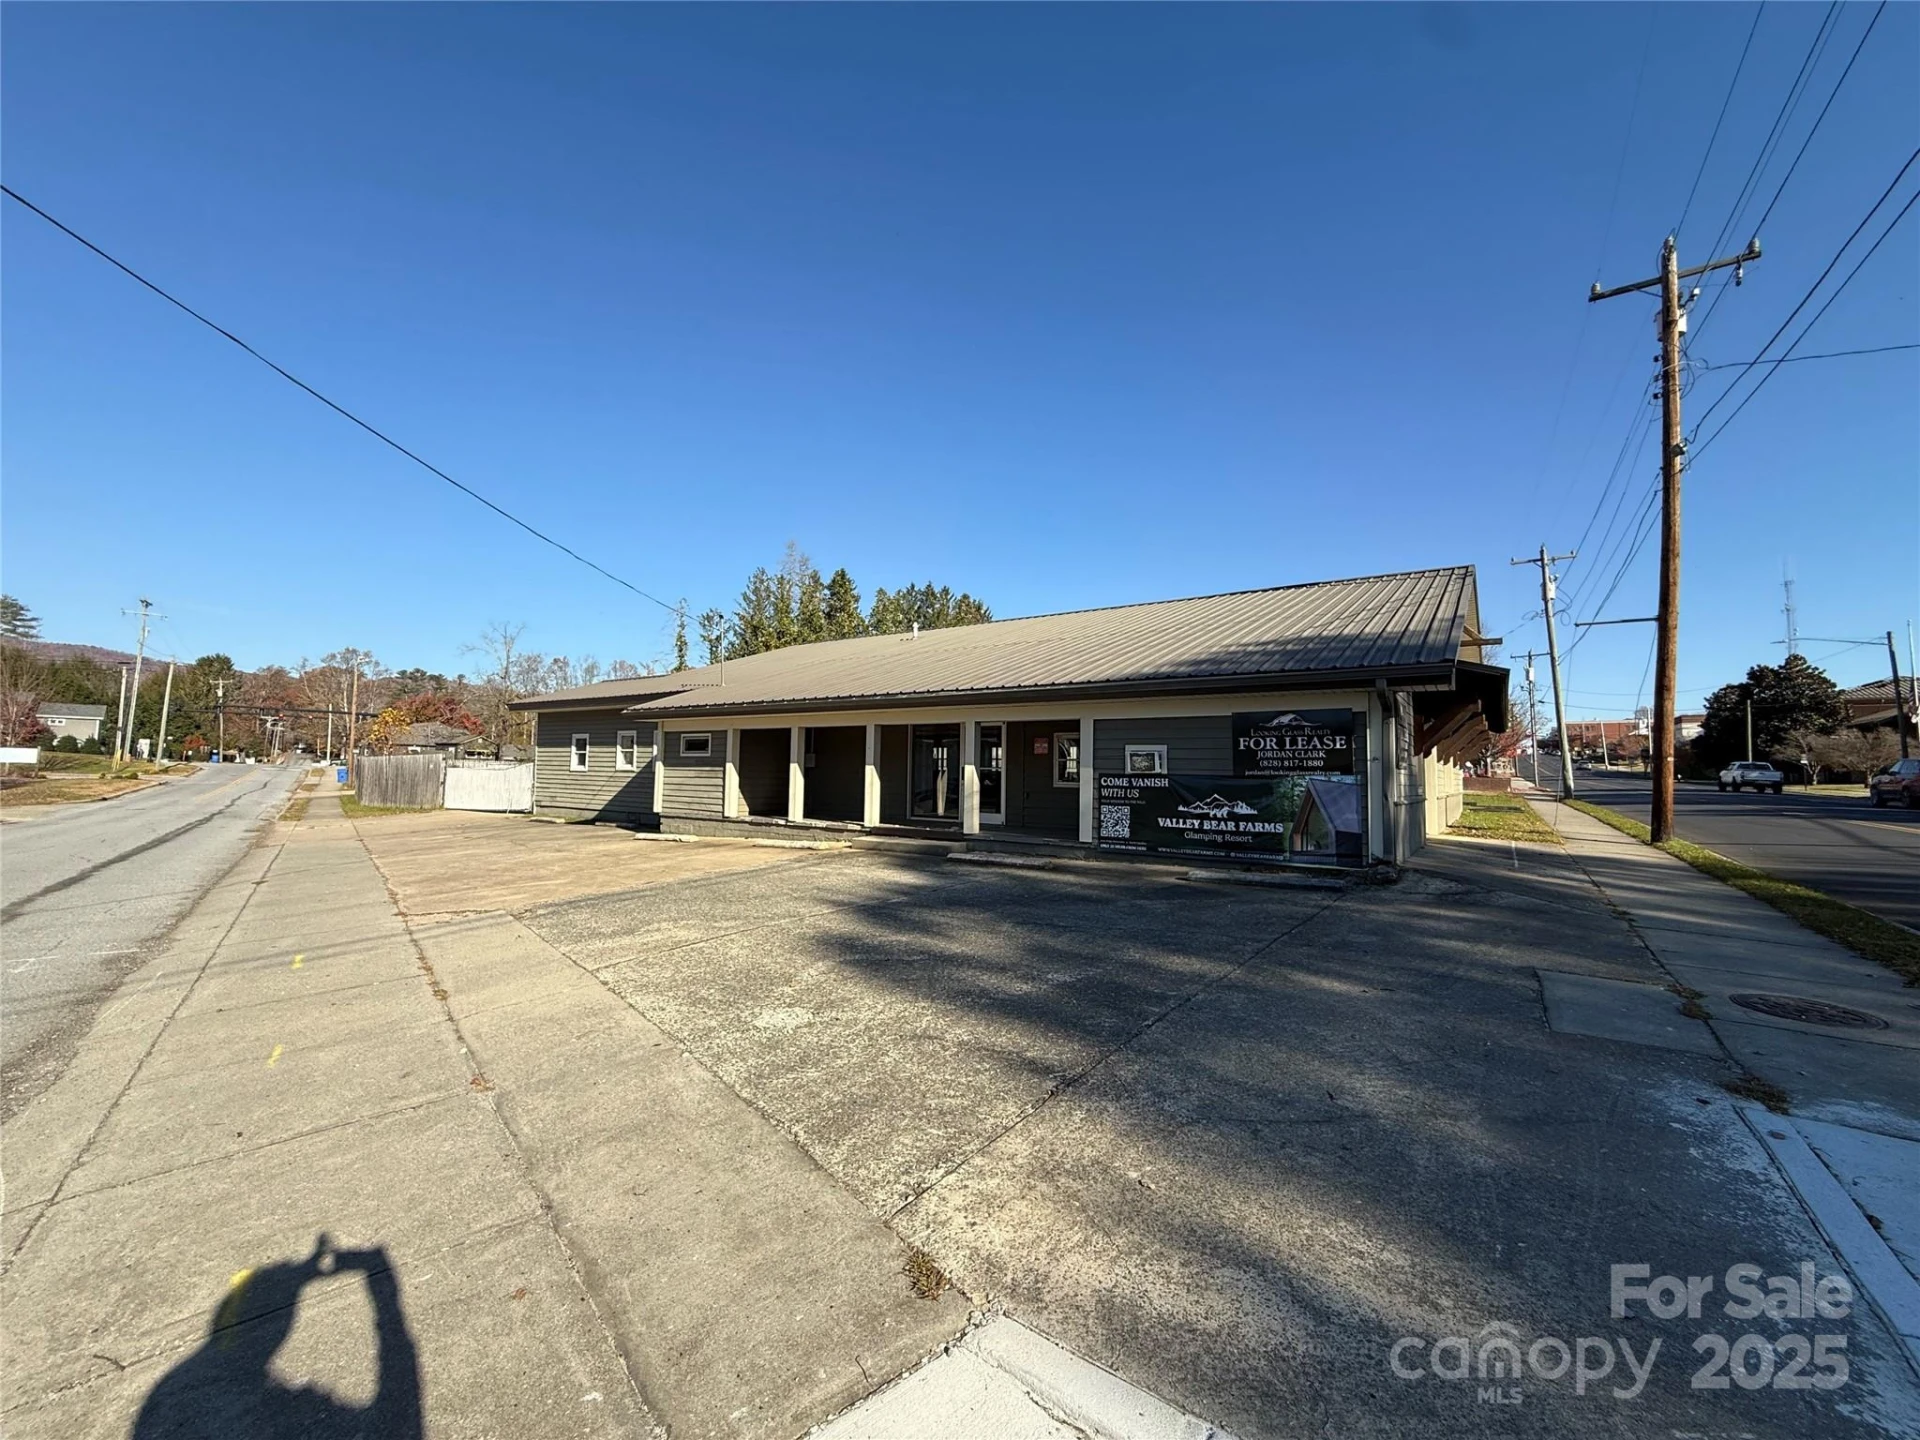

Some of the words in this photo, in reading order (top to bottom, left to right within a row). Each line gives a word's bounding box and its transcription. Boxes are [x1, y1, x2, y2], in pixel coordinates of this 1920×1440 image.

[1238, 737, 1279, 750] FOR
[1284, 735, 1347, 750] LEASE
[1257, 750, 1293, 759] JORDAN
[1295, 750, 1326, 758] CLARK
[1259, 759, 1282, 767] (828)
[1283, 759, 1324, 767] 817-1880
[1101, 777, 1129, 787] COME
[1131, 778, 1169, 788] VANISH
[1101, 788, 1125, 798] WITH
[1127, 788, 1140, 798] US
[1157, 817, 1201, 829] VALLEY
[1203, 819, 1237, 832] BEAR
[1239, 821, 1284, 833] FARMS
[1184, 831, 1223, 843] Glamping
[1225, 833, 1253, 843] Resort
